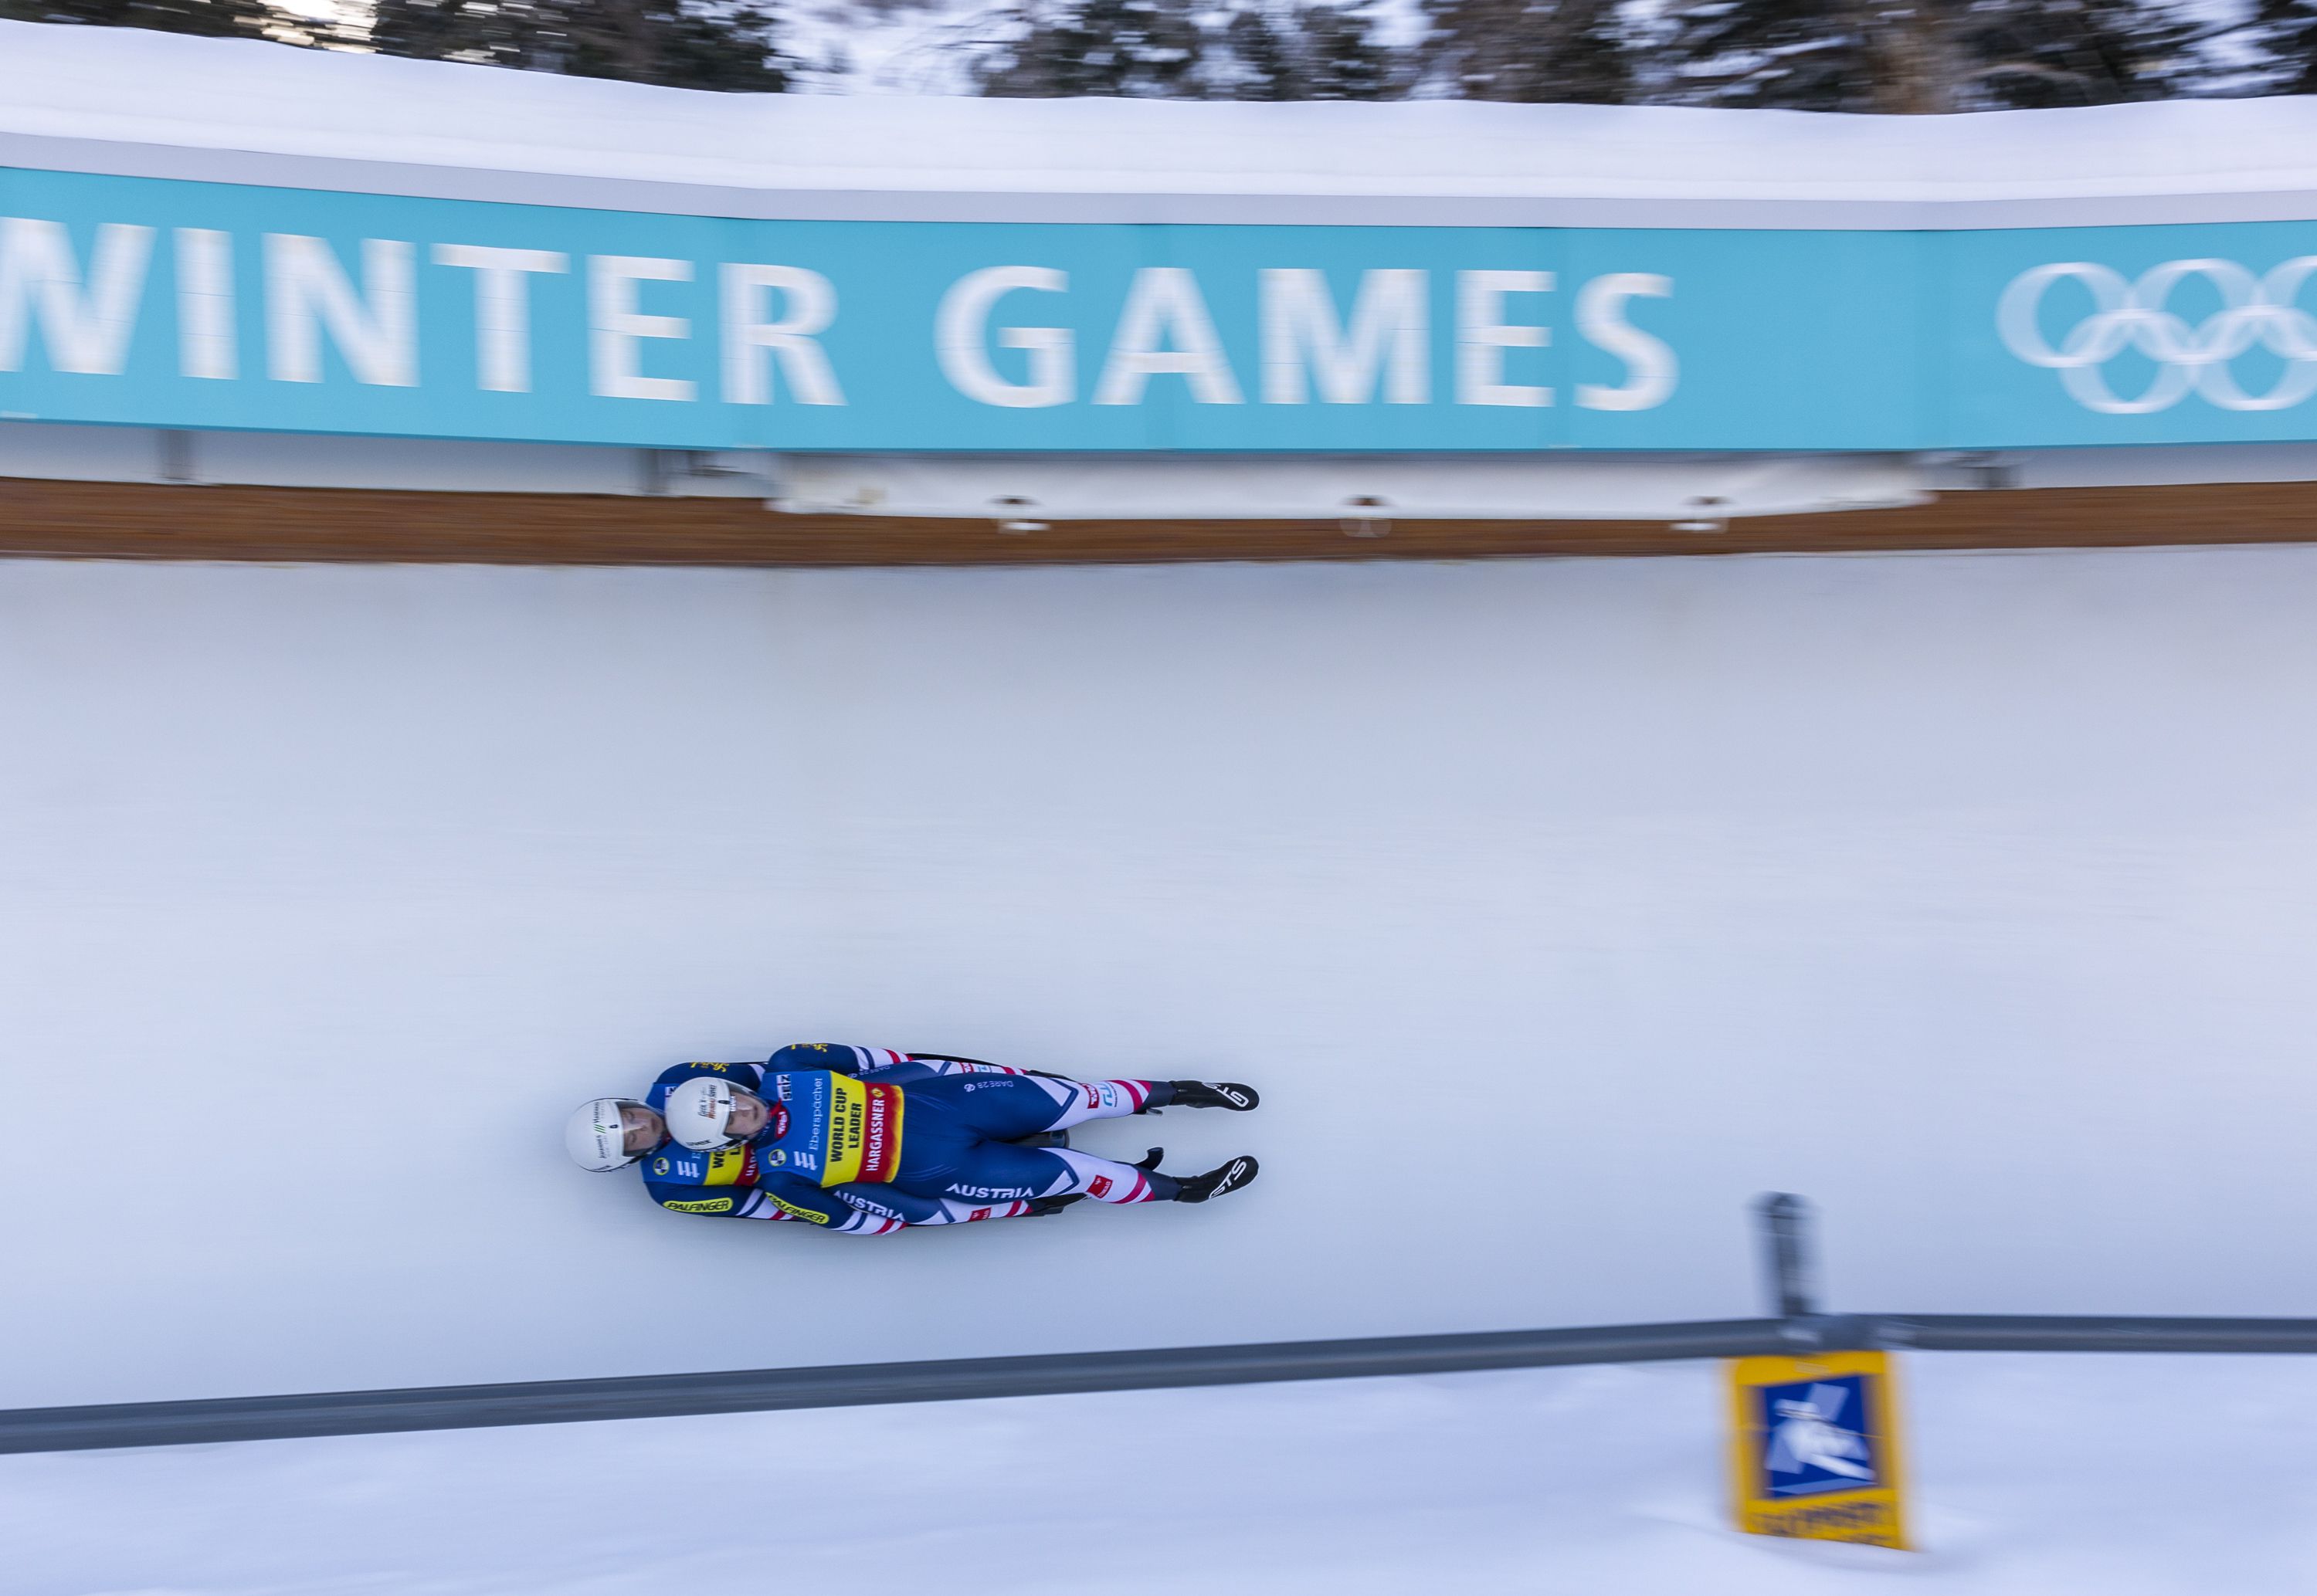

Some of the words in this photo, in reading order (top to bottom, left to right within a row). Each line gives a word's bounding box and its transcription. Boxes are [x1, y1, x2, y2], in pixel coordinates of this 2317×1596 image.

[0, 215, 848, 407] WINTER
[931, 264, 1681, 412] GAMES
[809, 1078, 823, 1150] Eberspächer
[834, 1088, 847, 1113] CUP
[830, 1117, 845, 1162] WORLD
[849, 1103, 862, 1148] LEADER
[865, 1100, 885, 1171] HARGASSNER
[945, 1183, 1034, 1198] AUSTRIA
[1209, 1159, 1247, 1198] GTS
[667, 1200, 729, 1211] PALFINGER
[768, 1194, 824, 1222] PALFINGER
[833, 1190, 905, 1221] AUSTRIA
